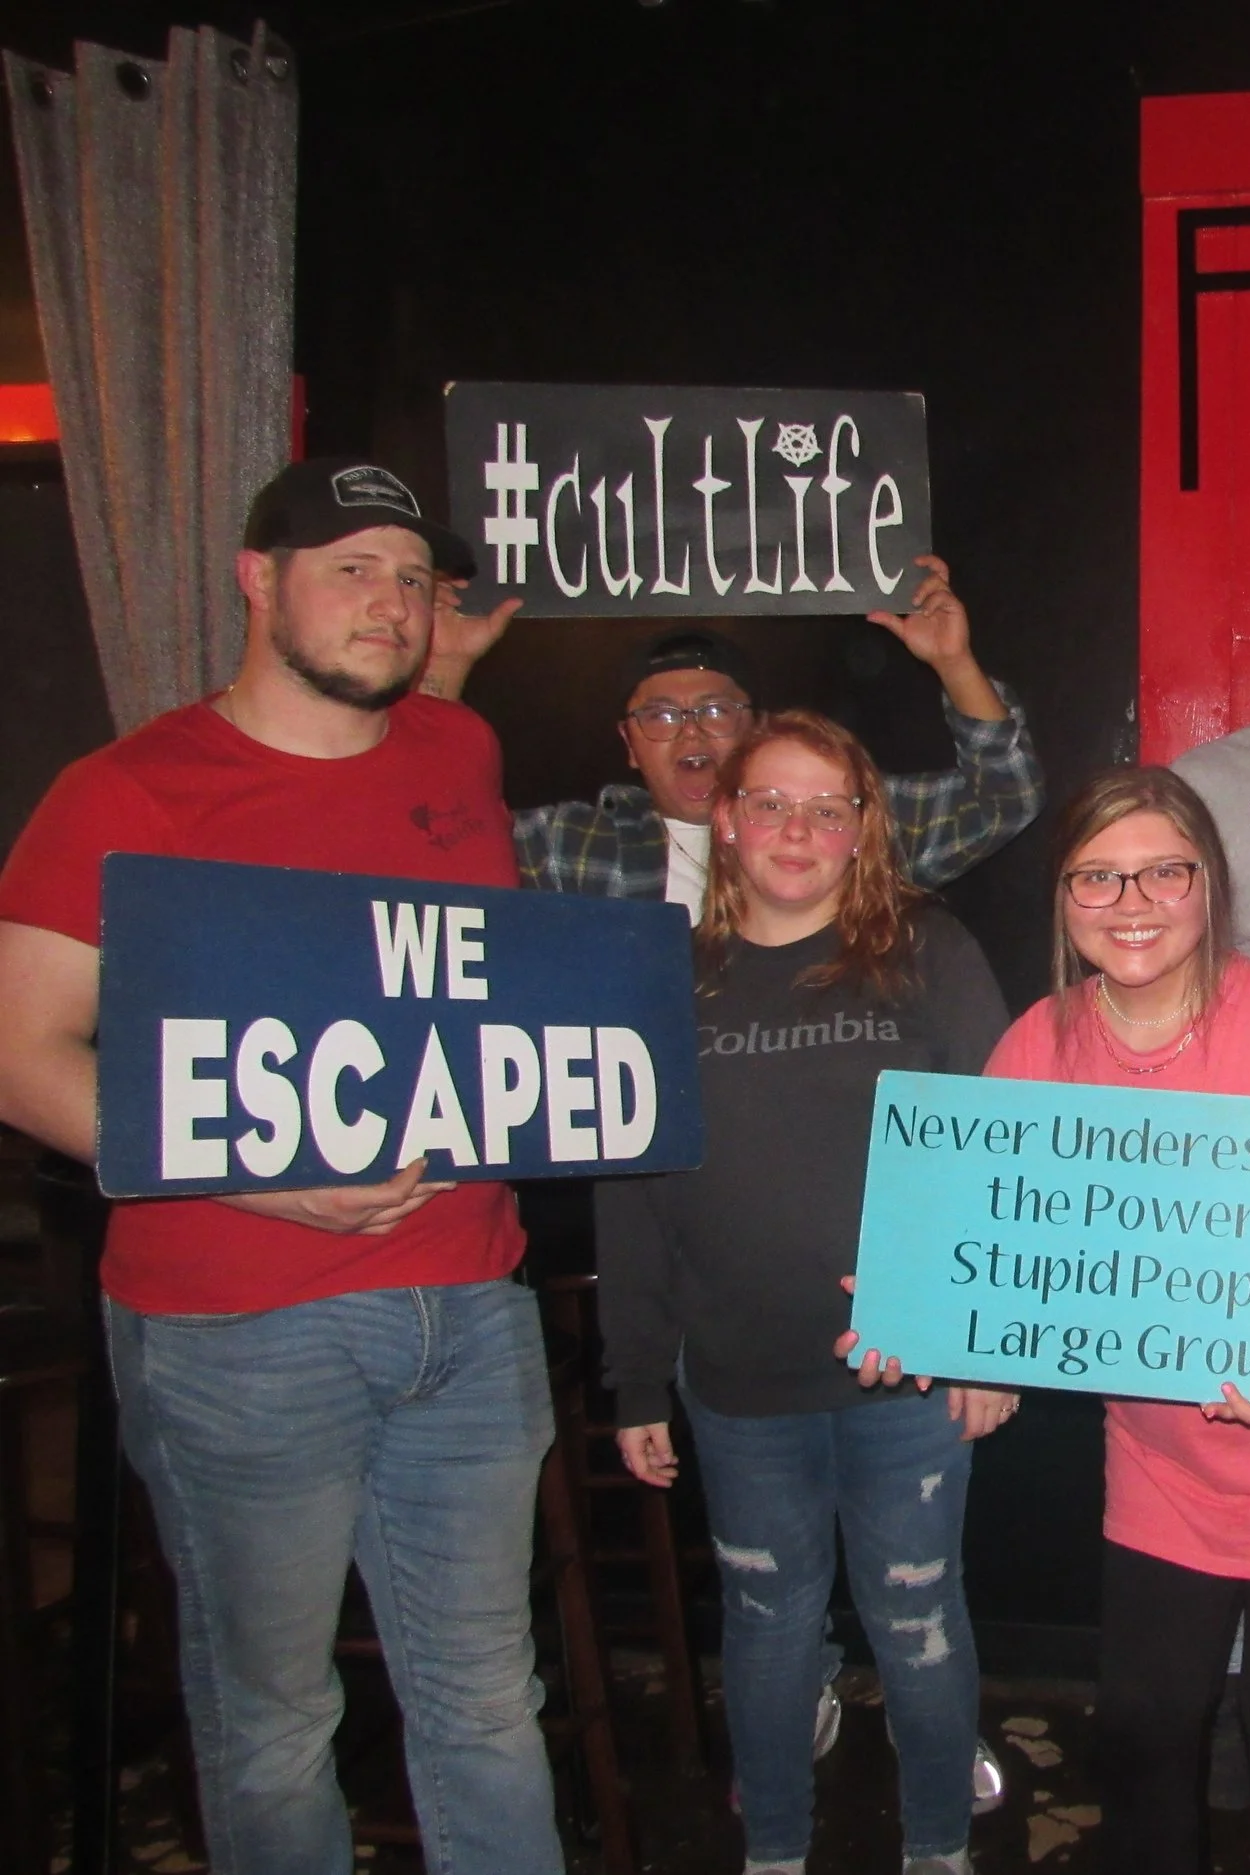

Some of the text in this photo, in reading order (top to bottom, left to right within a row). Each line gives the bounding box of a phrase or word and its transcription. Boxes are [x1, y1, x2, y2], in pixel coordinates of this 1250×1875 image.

[371, 900, 489, 1000] WE
[160, 1016, 658, 1181] ESCAPED
[885, 1103, 1039, 1156] Never
[987, 1175, 1070, 1225] the
[950, 1241, 1119, 1304] Stupid
[967, 1310, 1122, 1375] Large
